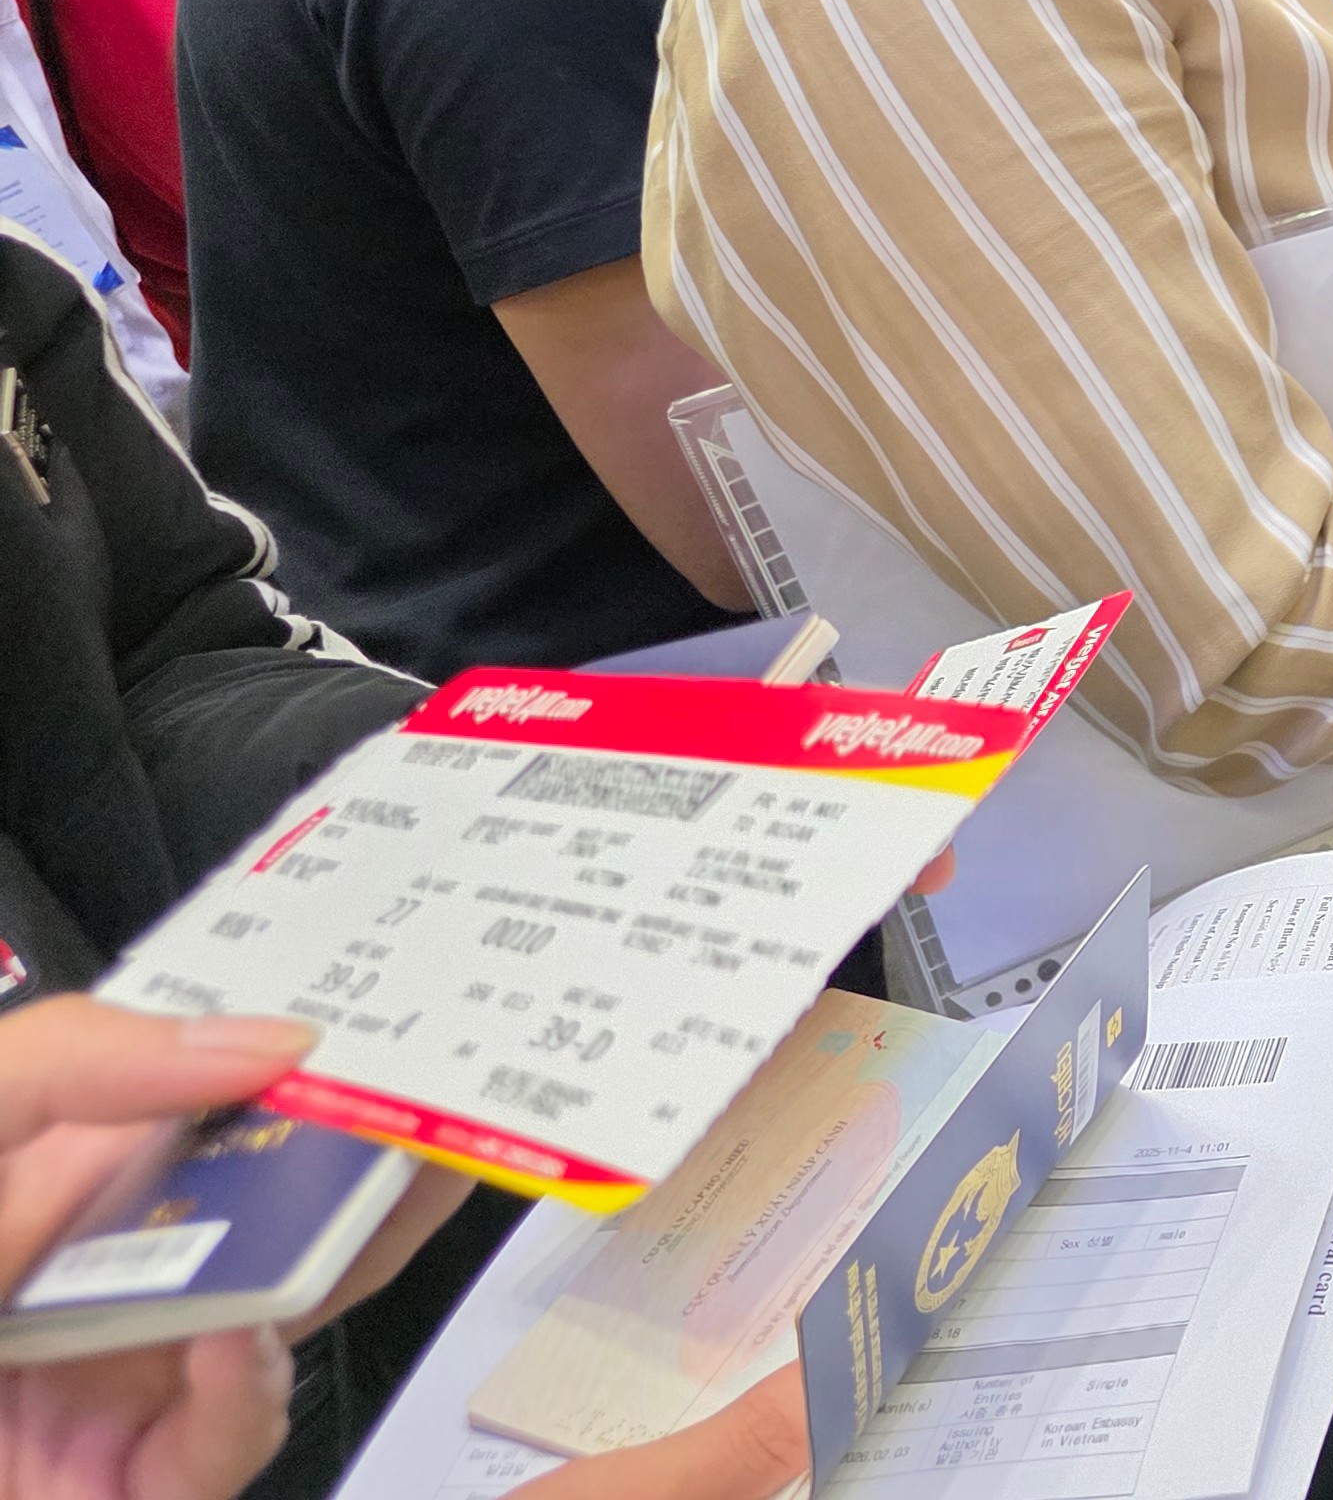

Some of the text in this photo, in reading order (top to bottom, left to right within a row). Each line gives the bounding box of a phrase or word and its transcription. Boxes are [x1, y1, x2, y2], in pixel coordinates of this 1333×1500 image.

[376, 896, 422, 925] 27
[1295, 898, 1306, 915] Date
[1309, 913, 1326, 938] Name
[1277, 927, 1295, 949] Birth
[1199, 1142, 1231, 1154] 11:01
[1060, 1239, 1080, 1250] Sex
[1308, 1271, 1333, 1316] card
[1085, 1377, 1130, 1393] Single
[973, 1390, 1023, 1406] Entries
[946, 1424, 995, 1440] Issuing
[1044, 1414, 1144, 1435] Korean Embassy
[939, 1435, 1004, 1453] Authority
[1041, 1432, 1111, 1449] in Vietnam
